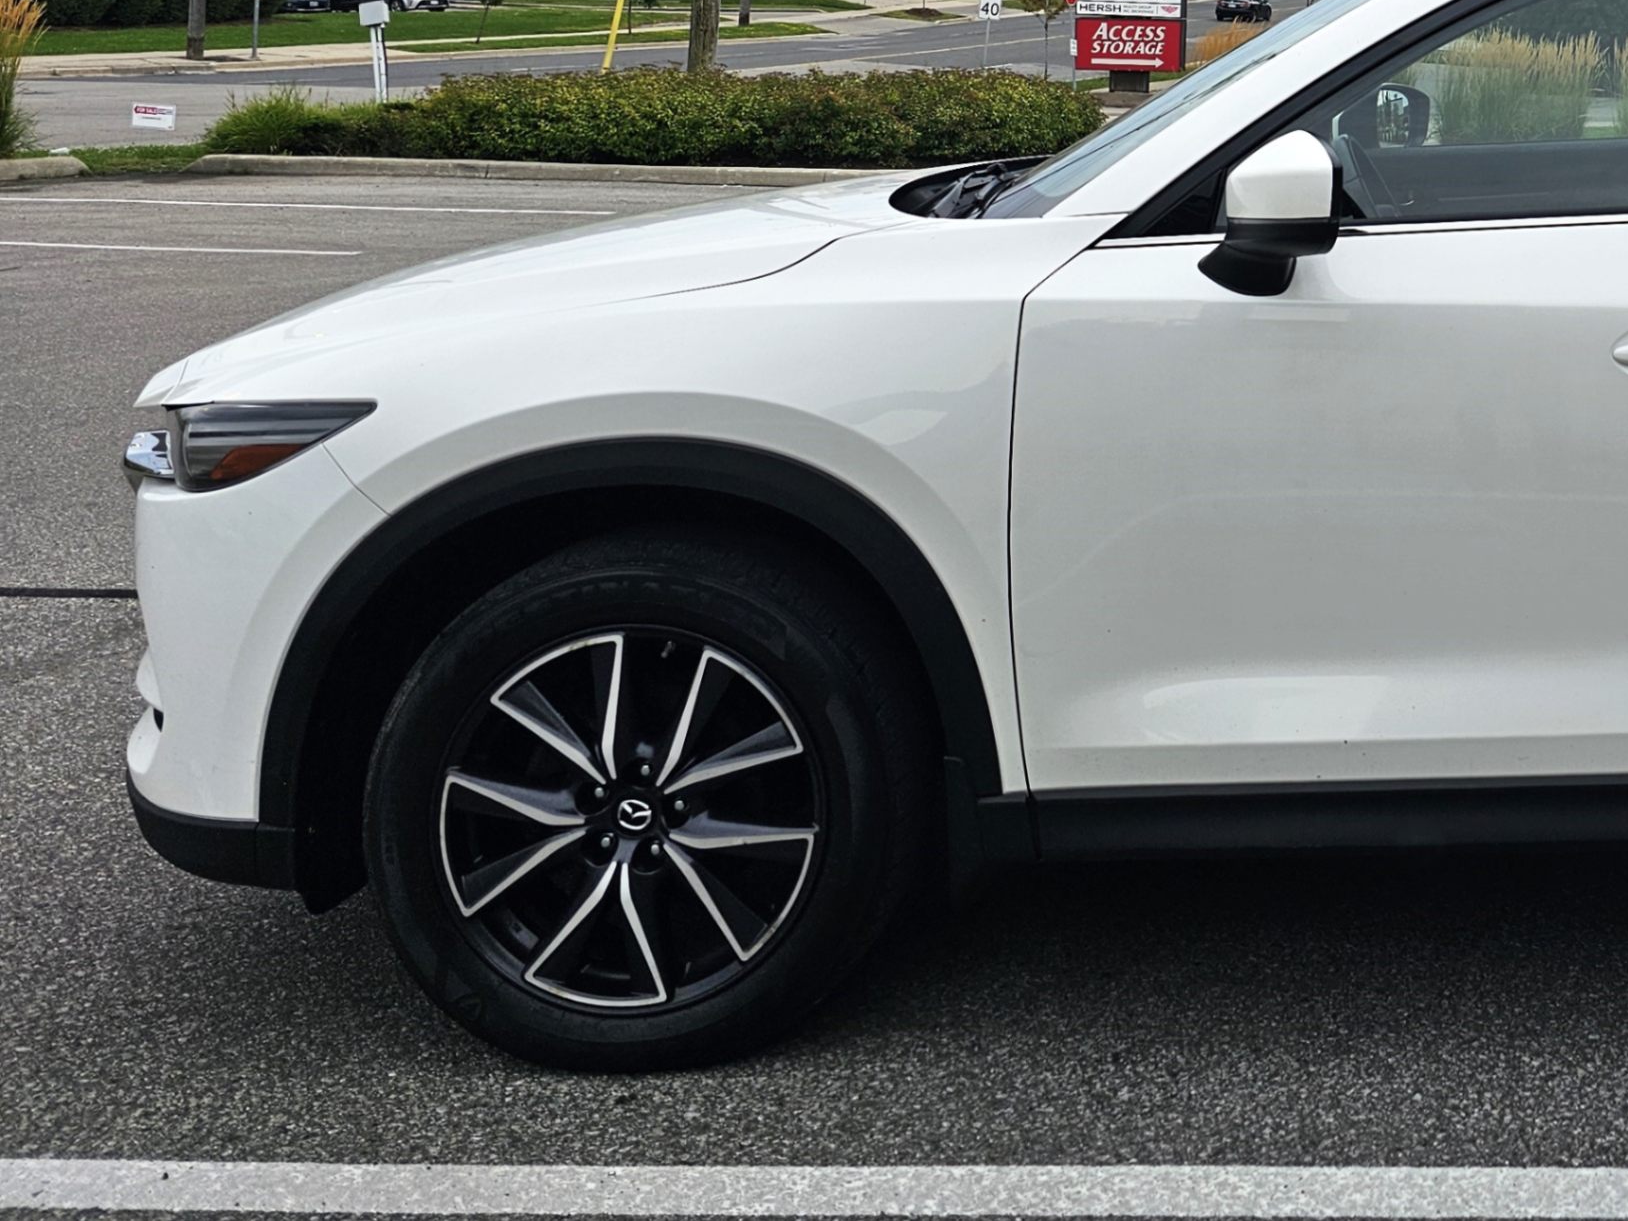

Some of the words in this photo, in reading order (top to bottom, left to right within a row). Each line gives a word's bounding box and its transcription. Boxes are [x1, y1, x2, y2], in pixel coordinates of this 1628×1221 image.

[981, 2, 1000, 16] 40
[1079, 4, 1122, 13] HERSH
[1092, 22, 1166, 41] ACCESS
[1091, 40, 1165, 55] STORAGE
